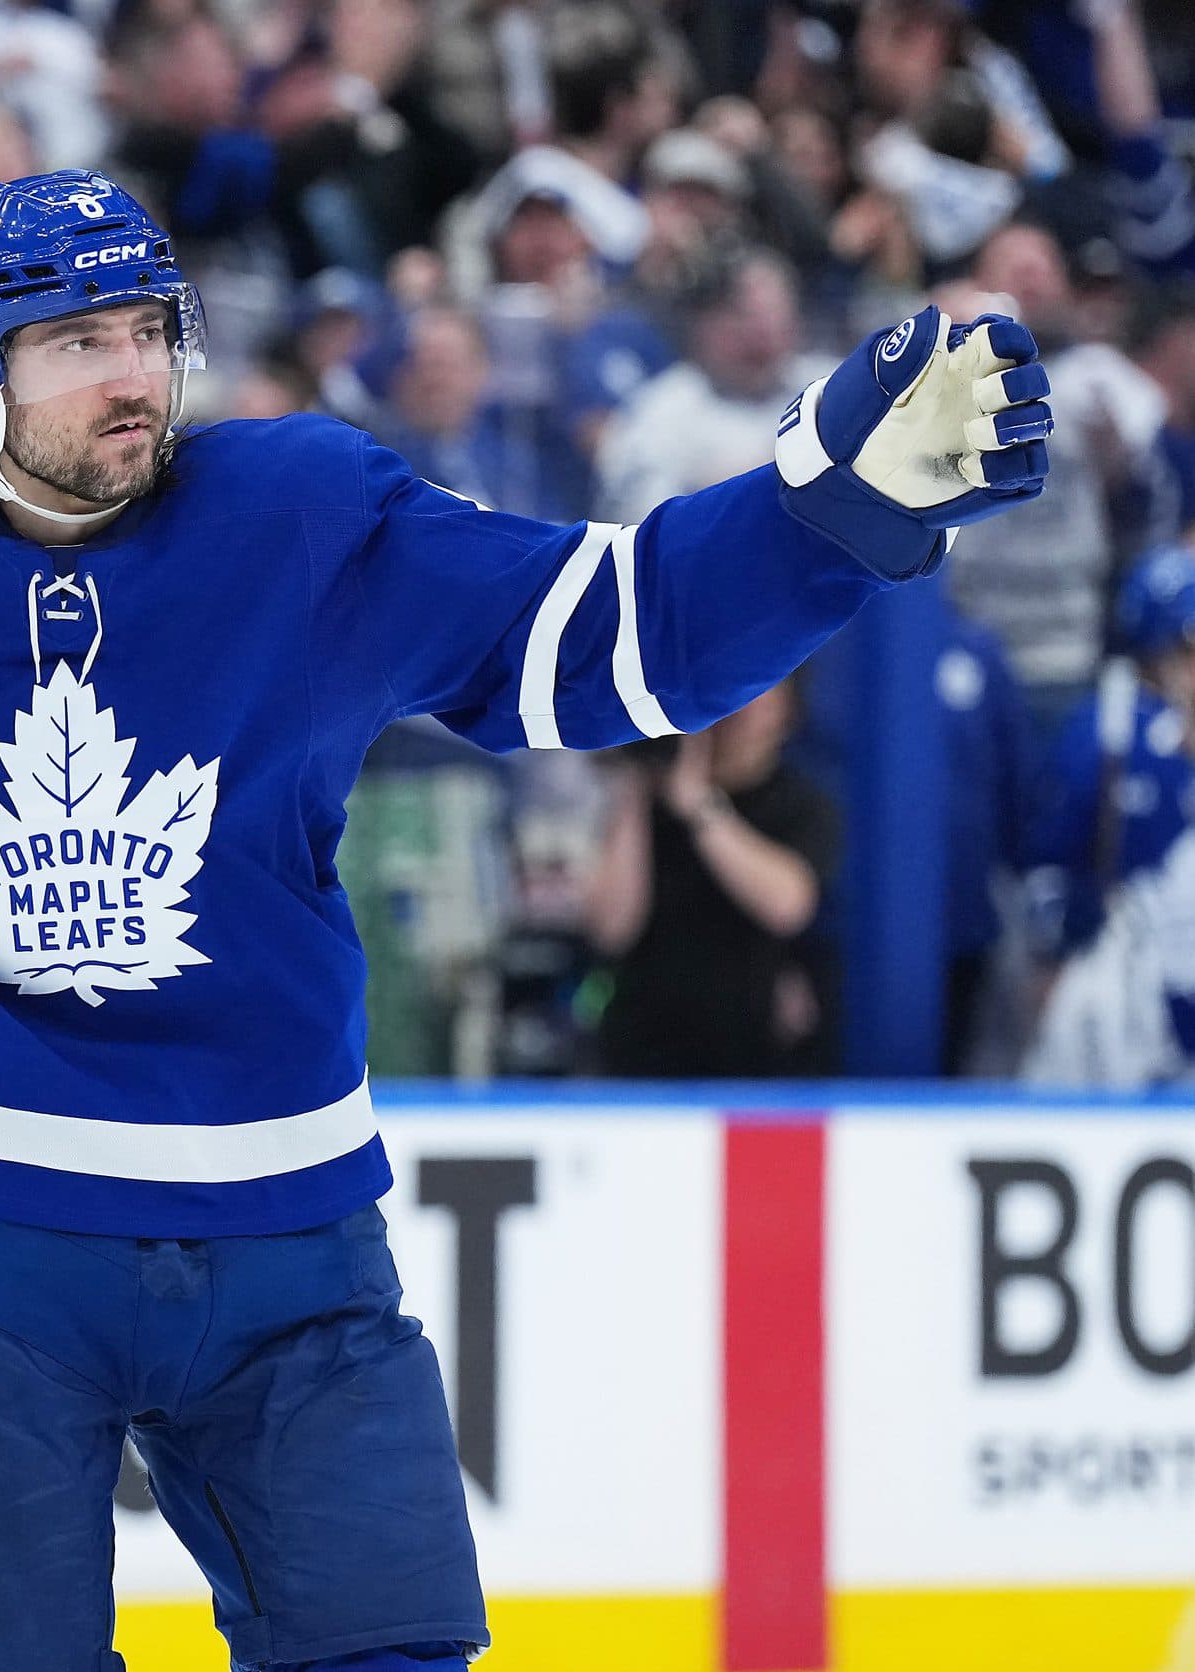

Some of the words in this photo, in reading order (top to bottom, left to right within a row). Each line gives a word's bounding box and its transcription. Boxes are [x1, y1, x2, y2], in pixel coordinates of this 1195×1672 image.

[73, 241, 147, 270] CCM
[8, 877, 144, 916] MAPLE
[12, 916, 147, 953] LEAFS
